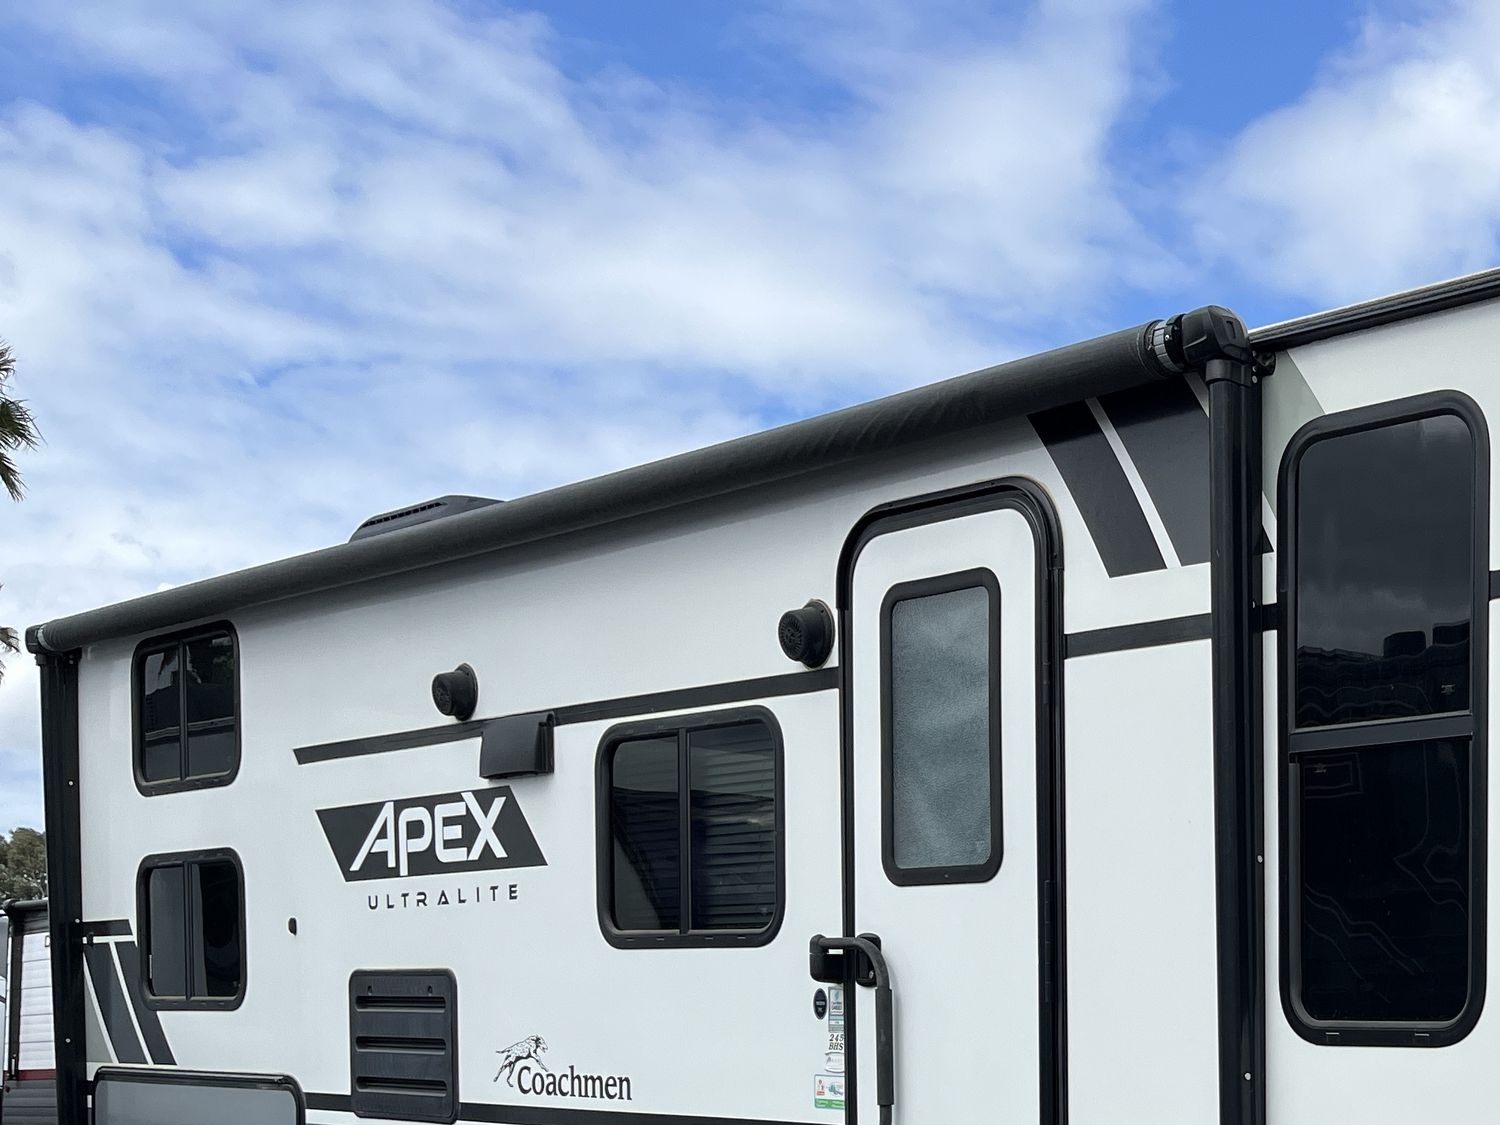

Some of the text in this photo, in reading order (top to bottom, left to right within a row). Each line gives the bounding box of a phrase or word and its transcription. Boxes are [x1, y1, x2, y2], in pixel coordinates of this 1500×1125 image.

[349, 791, 509, 877] APEX
[367, 883, 519, 911] ULTRALITE
[517, 1064, 632, 1101] Coachmen
